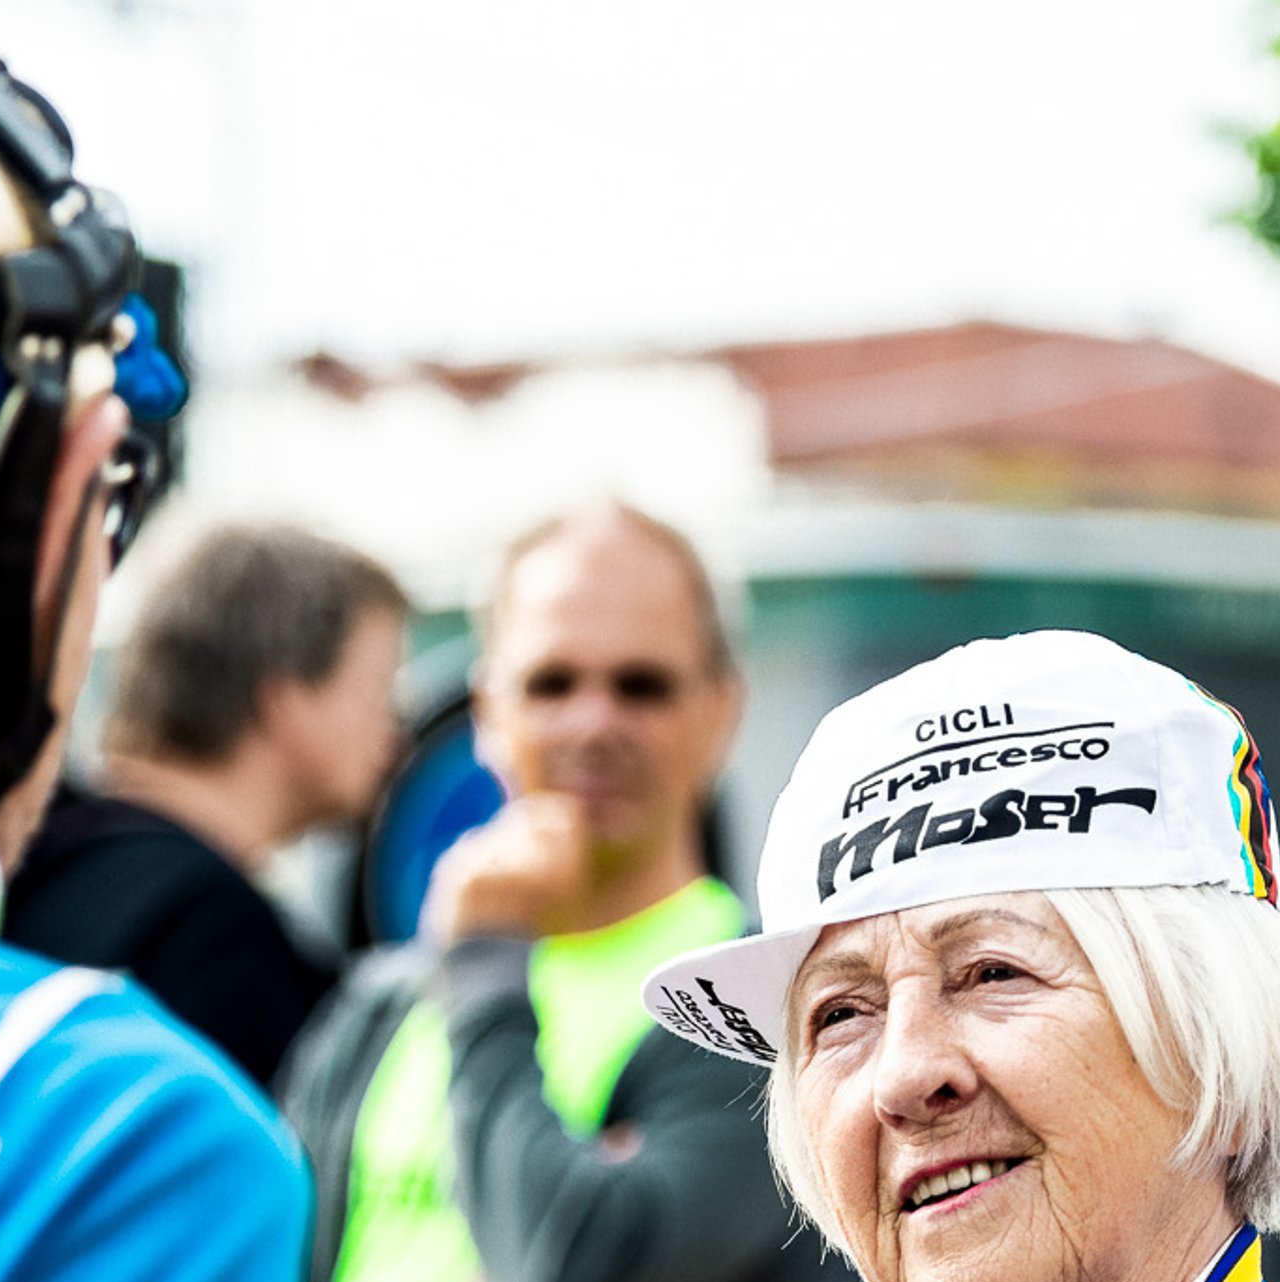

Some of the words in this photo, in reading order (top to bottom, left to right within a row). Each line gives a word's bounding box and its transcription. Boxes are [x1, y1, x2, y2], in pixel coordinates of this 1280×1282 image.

[915, 702, 1015, 743] CICLI
[842, 737, 1111, 819] Francesco
[817, 786, 1157, 903] Moser
